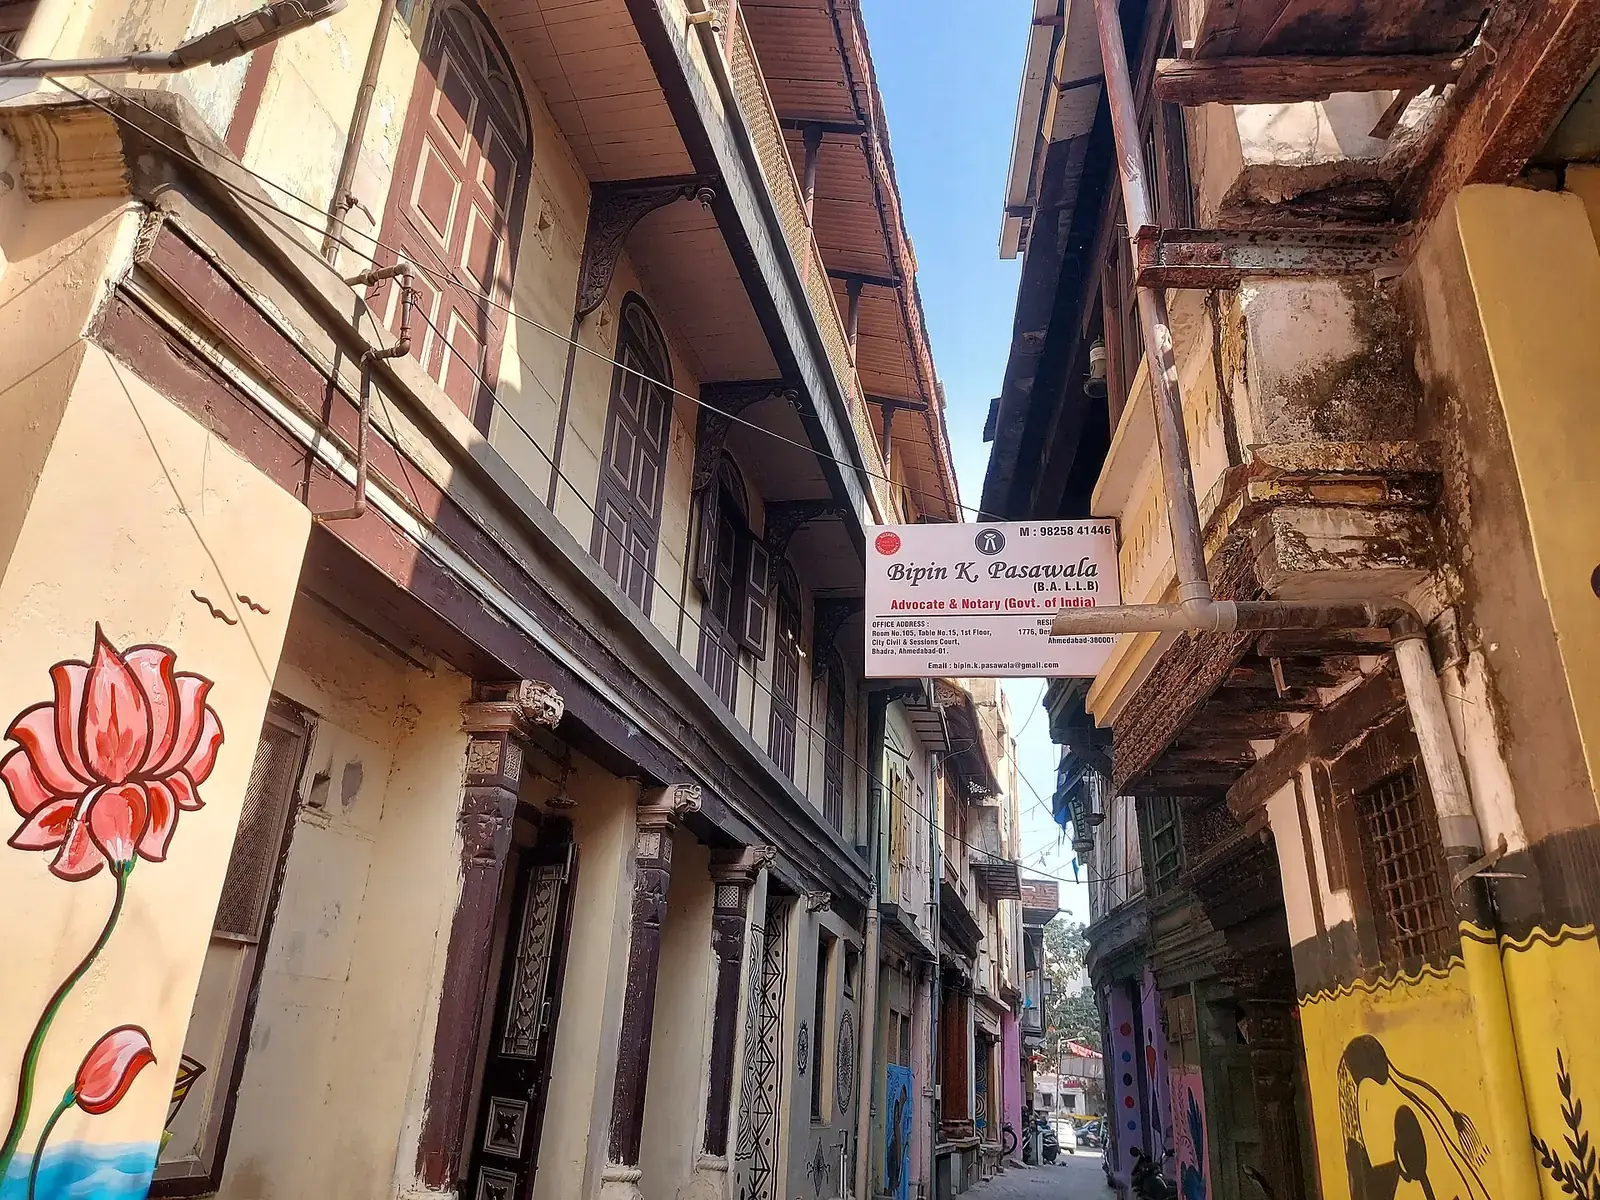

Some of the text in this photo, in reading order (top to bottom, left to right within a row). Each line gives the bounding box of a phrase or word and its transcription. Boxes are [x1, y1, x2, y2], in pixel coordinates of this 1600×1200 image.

[1020, 527, 1029, 536] M
[1040, 526, 1073, 536] 98258
[1076, 525, 1112, 535] 41446
[887, 562, 947, 586] Bipin
[988, 556, 1099, 580] Pasawala
[1034, 581, 1098, 593] (B.A. L.L.B)
[891, 596, 1097, 610] Advocate & Notary (Govt. of India)
[871, 621, 895, 629] OFFICE
[895, 620, 926, 628] ADDRESS
[891, 629, 917, 637] No.105,
[917, 629, 936, 637] Table
[936, 629, 959, 637] No.15,
[972, 629, 992, 637] Floor,
[871, 638, 960, 647] City Civil & Sessions Court,
[871, 647, 949, 656] Bhadra, Ahmedabad-01.
